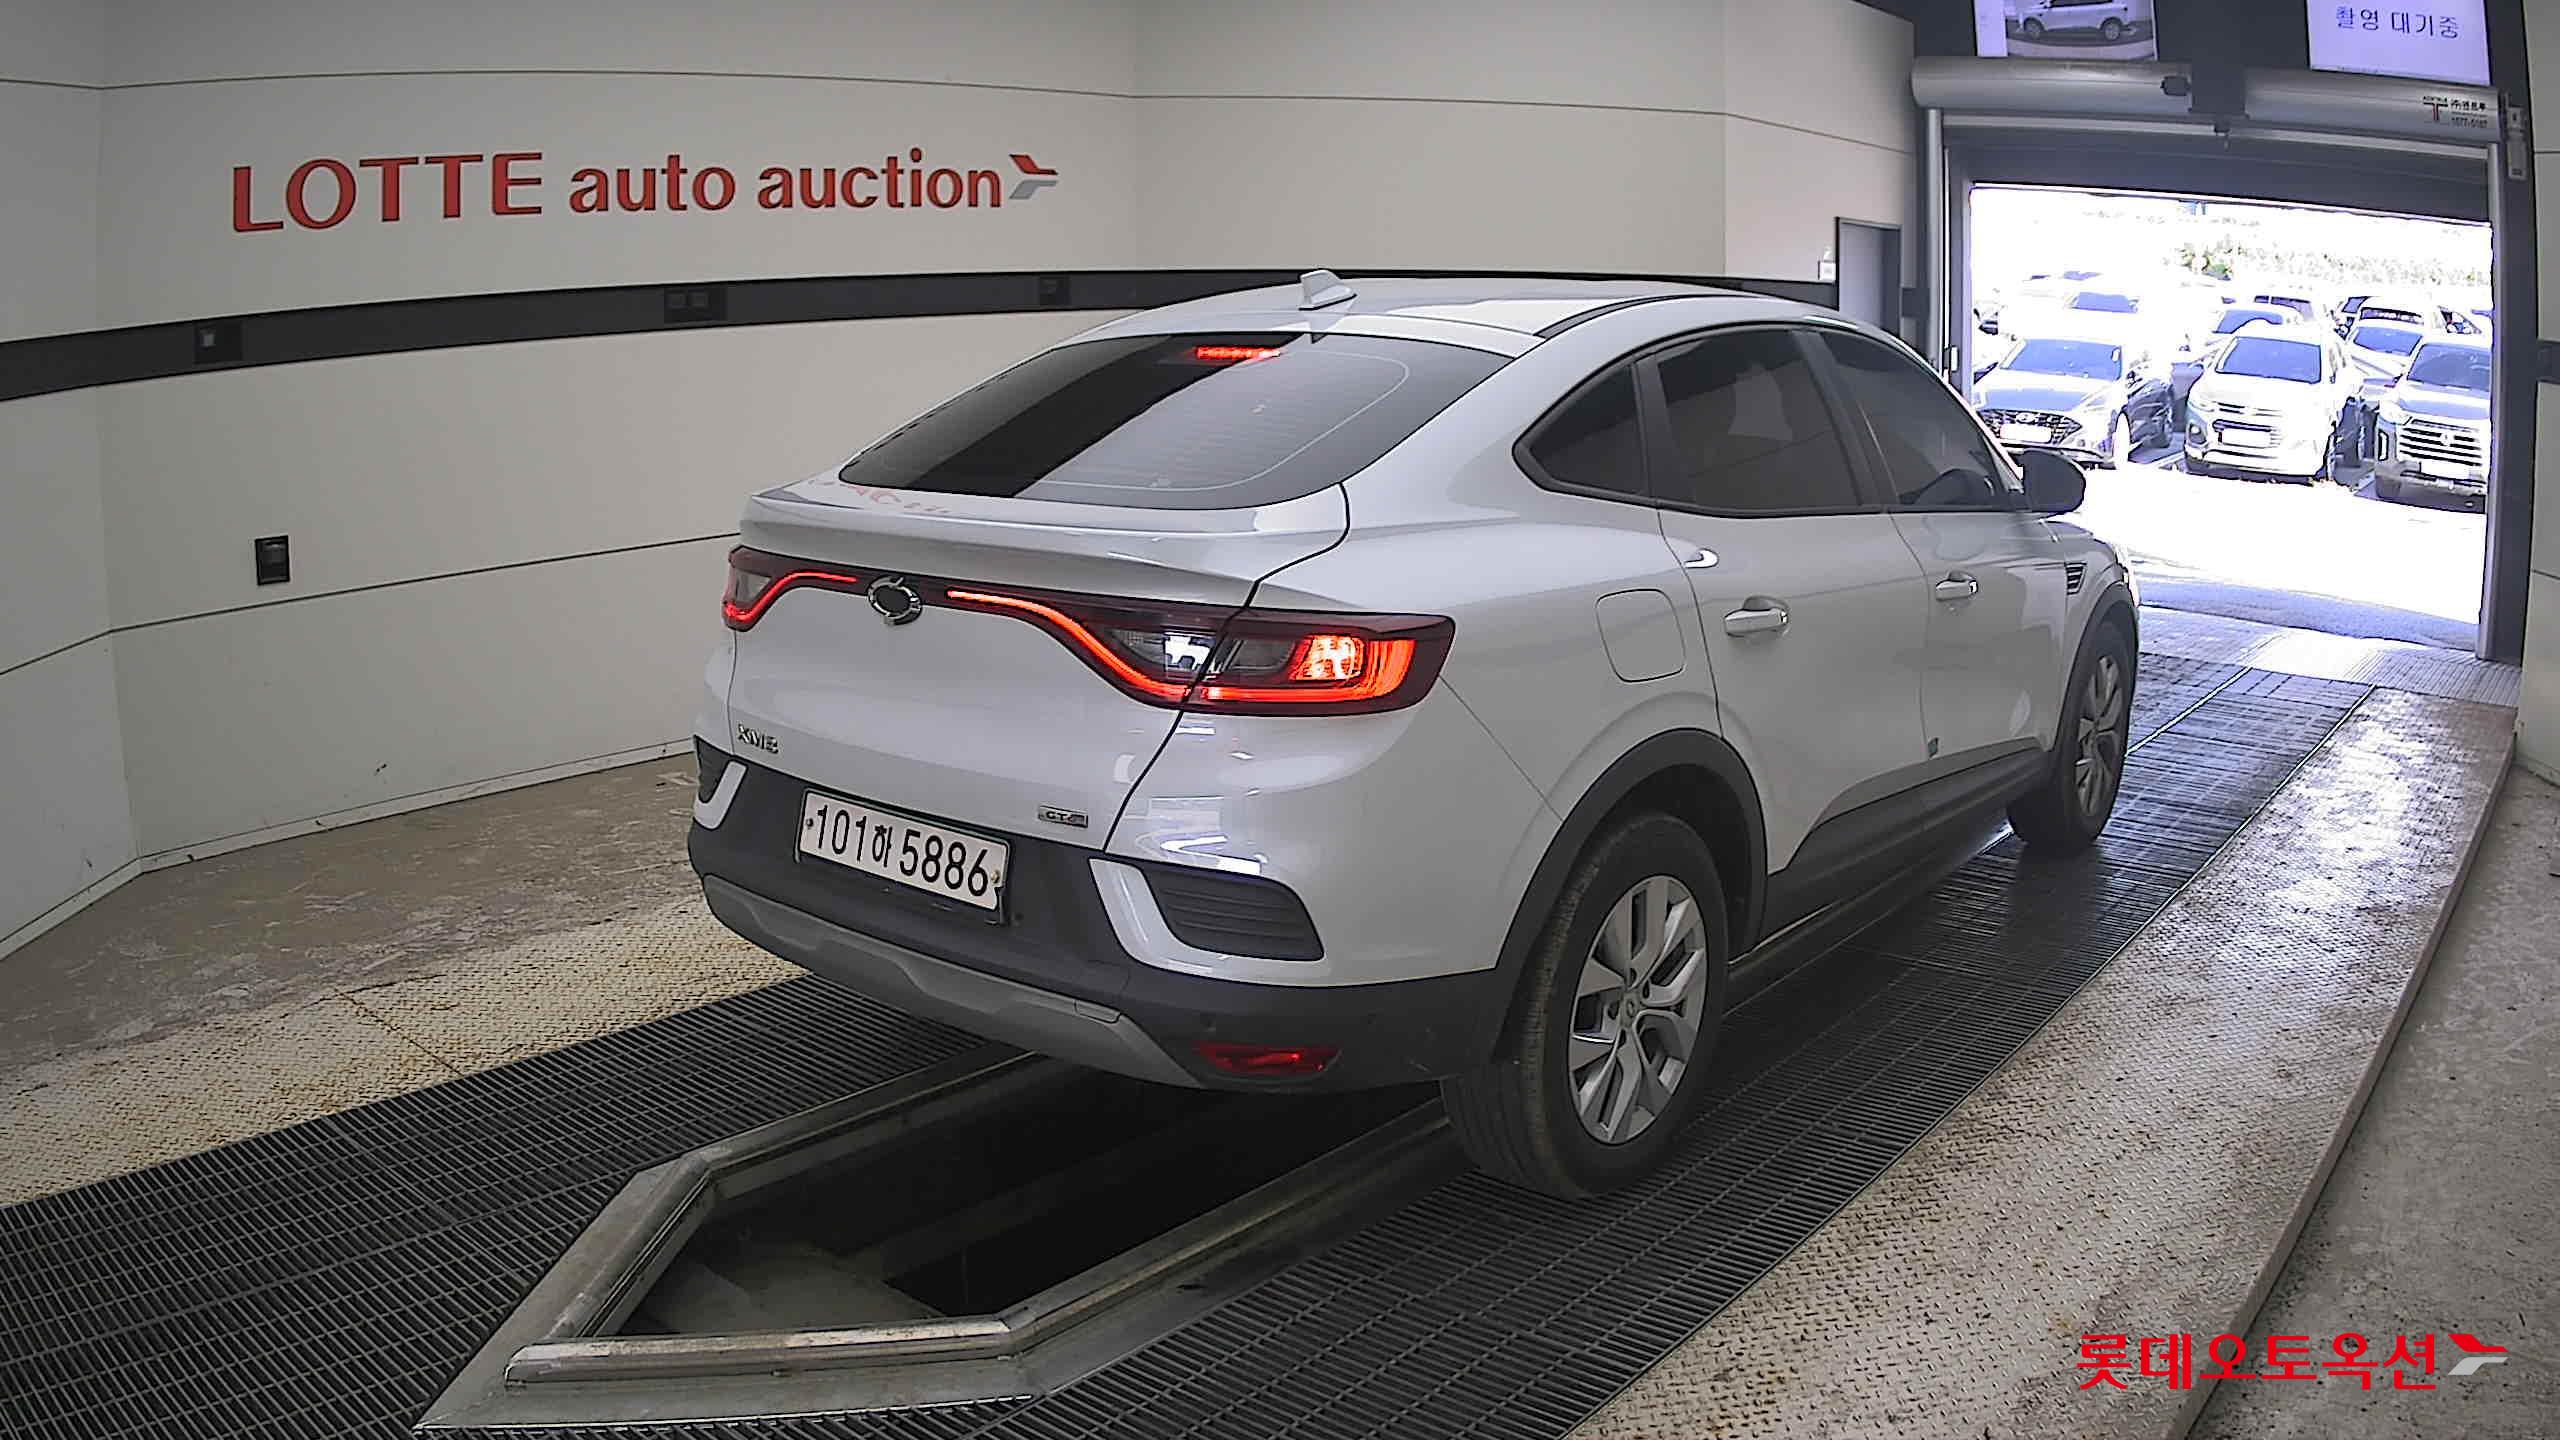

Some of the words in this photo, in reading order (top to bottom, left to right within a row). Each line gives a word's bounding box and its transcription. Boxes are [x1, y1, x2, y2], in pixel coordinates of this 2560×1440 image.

[2391, 12, 2459, 39] 대기중
[232, 152, 543, 233] LOTTE
[569, 154, 735, 212] auto
[757, 147, 1002, 209] auction
